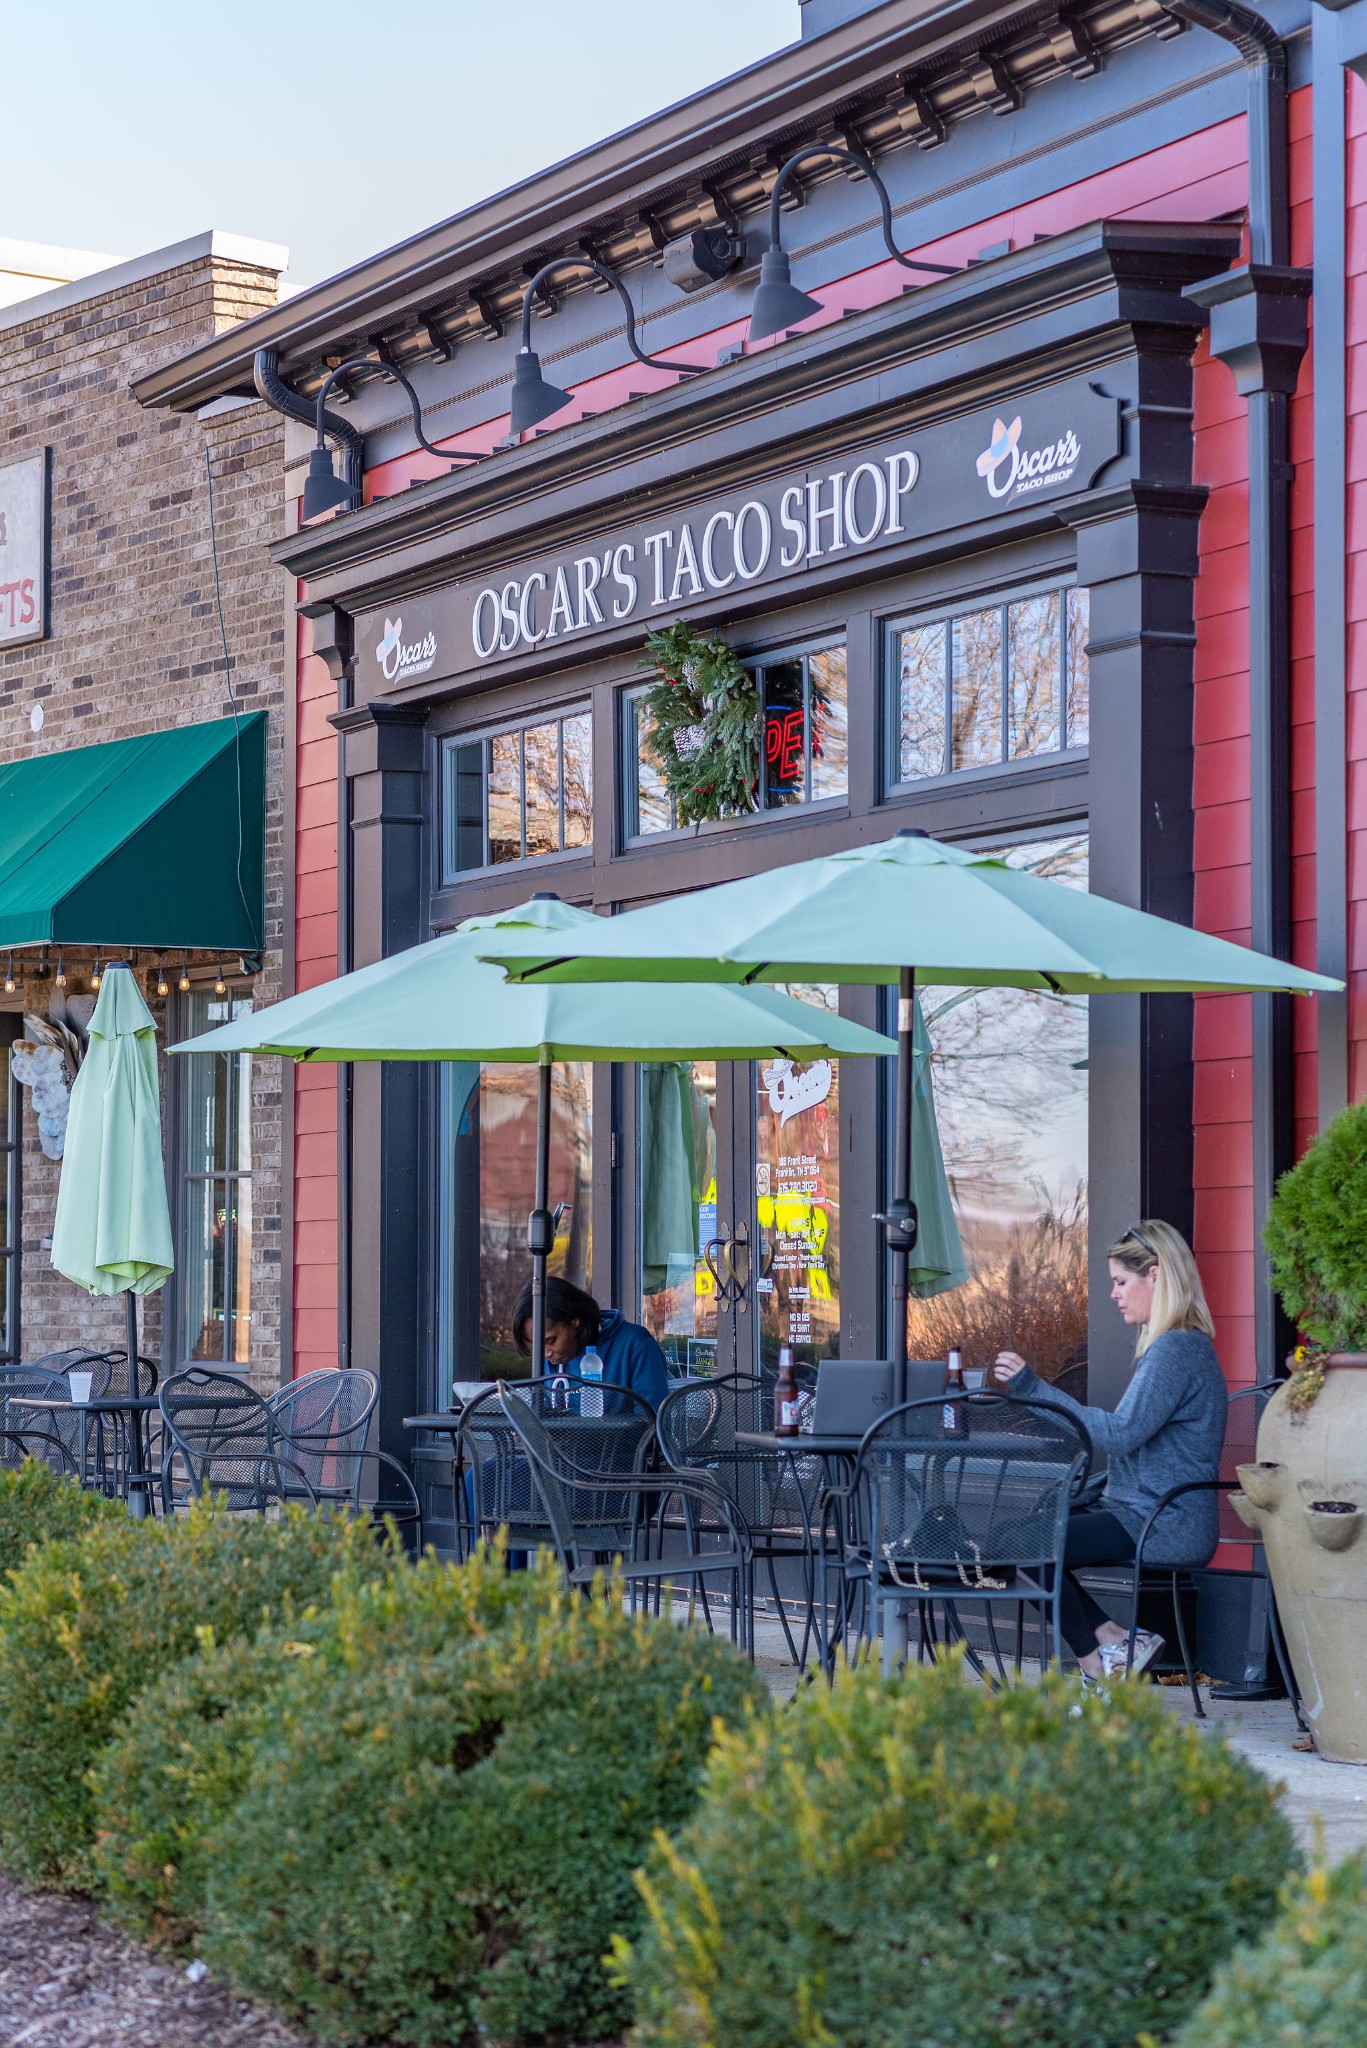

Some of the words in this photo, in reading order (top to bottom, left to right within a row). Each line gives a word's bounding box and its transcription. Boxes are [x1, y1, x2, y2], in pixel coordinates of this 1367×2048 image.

[985, 429, 1081, 498] Oscar's
[1016, 477, 1043, 493] TACO
[1043, 468, 1073, 486] SHOP
[472, 544, 638, 658] OSCAR'S
[644, 501, 772, 607] TACO
[780, 450, 920, 567] SHOP
[382, 630, 438, 679] Oscar's
[400, 665, 415, 676] TACO
[415, 660, 433, 672] SHOP
[787, 1156, 801, 1166] Front
[801, 1154, 817, 1165] Street
[775, 1230, 787, 1240] Mon
[780, 1240, 797, 1250] Closed
[797, 1240, 817, 1251] Sunday
